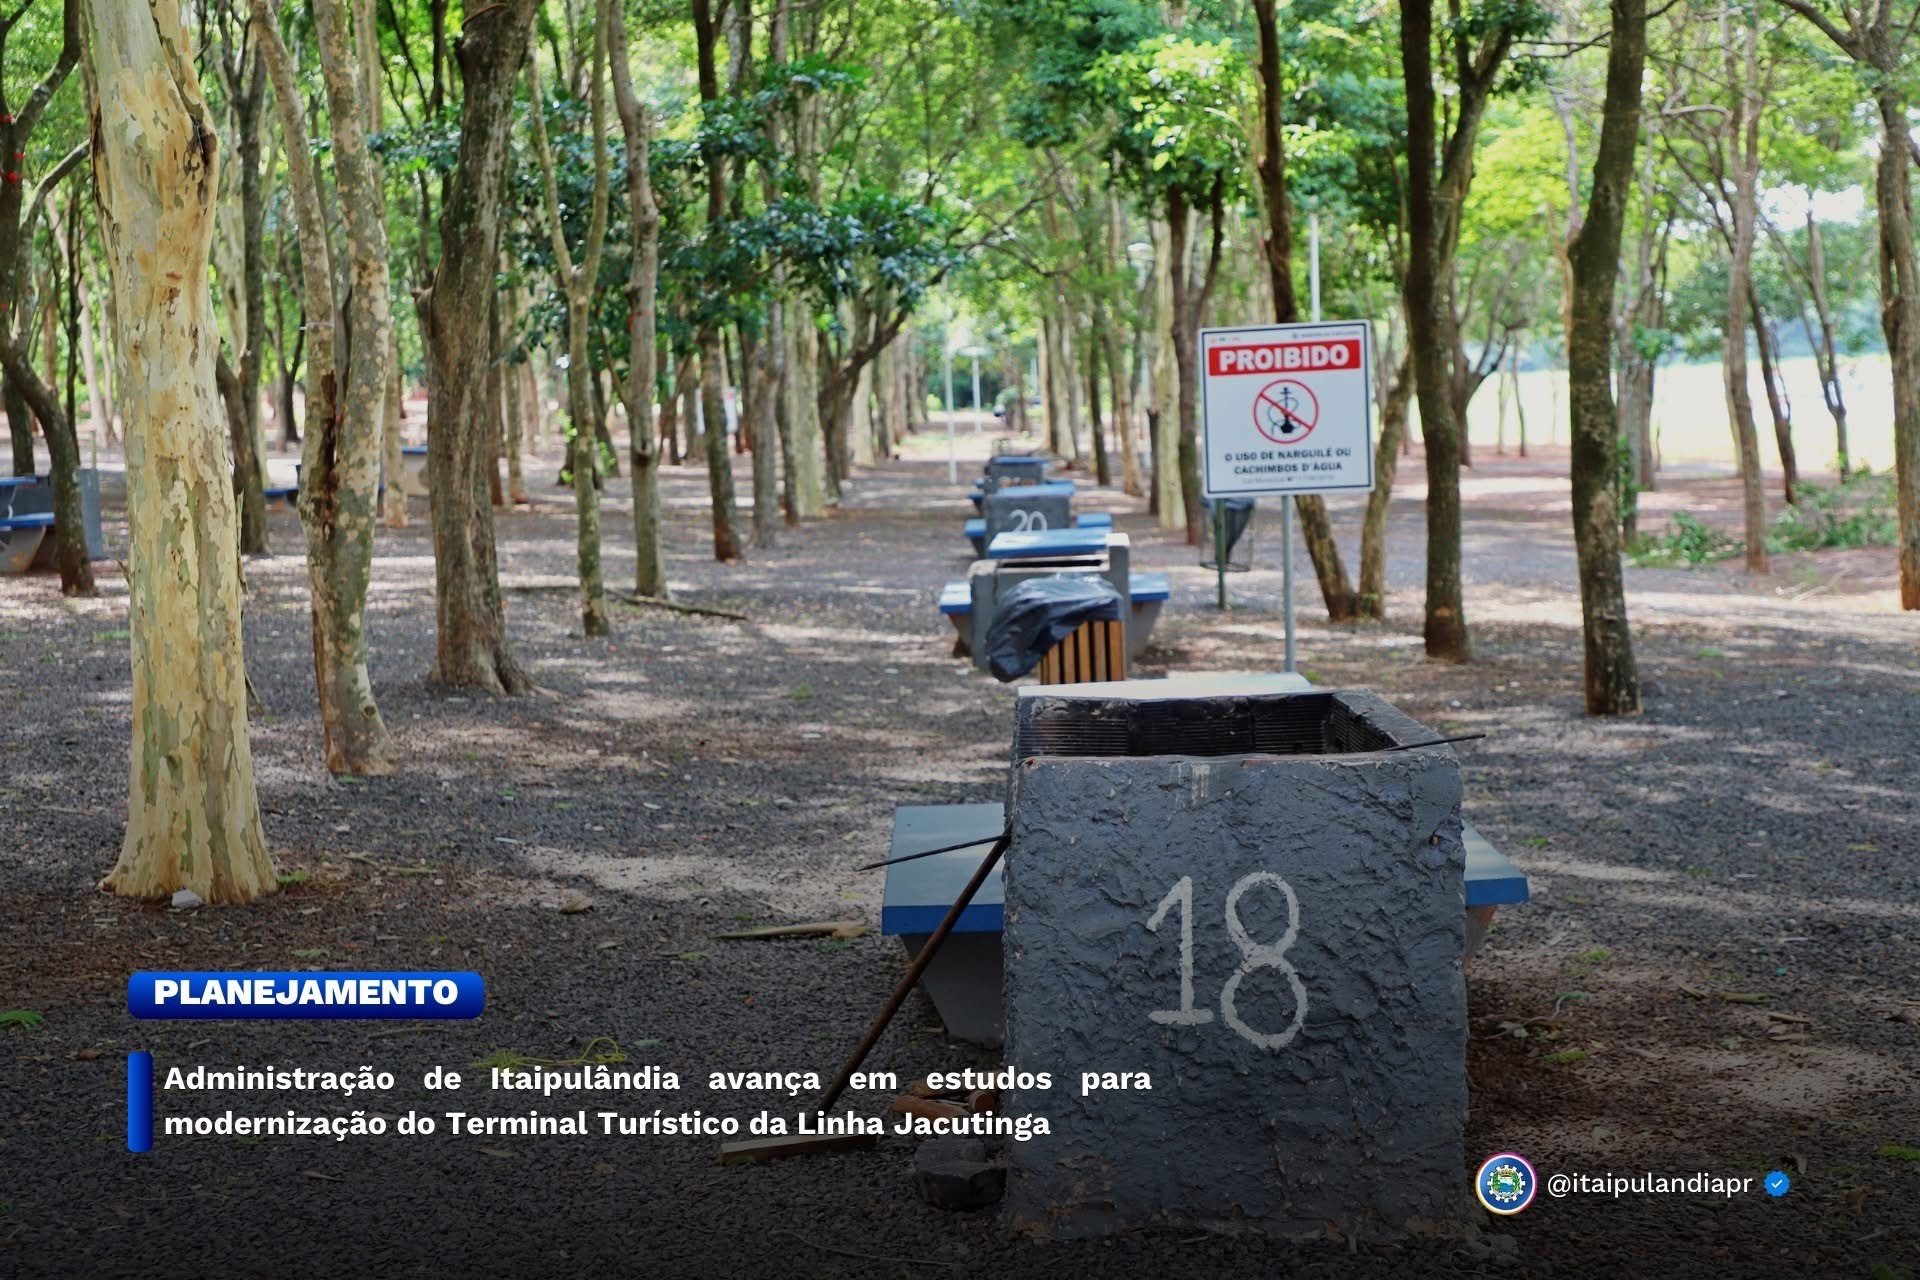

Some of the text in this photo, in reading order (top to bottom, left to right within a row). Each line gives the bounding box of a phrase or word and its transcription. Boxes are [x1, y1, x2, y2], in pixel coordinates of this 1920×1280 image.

[1219, 343, 1349, 372] PROIBIDO
[1224, 447, 1352, 462] O USO DE NARGUILÉ OU
[1234, 464, 1298, 475] CACHIMBOS
[1008, 509, 1048, 532] 20
[1146, 871, 1309, 1050] 18
